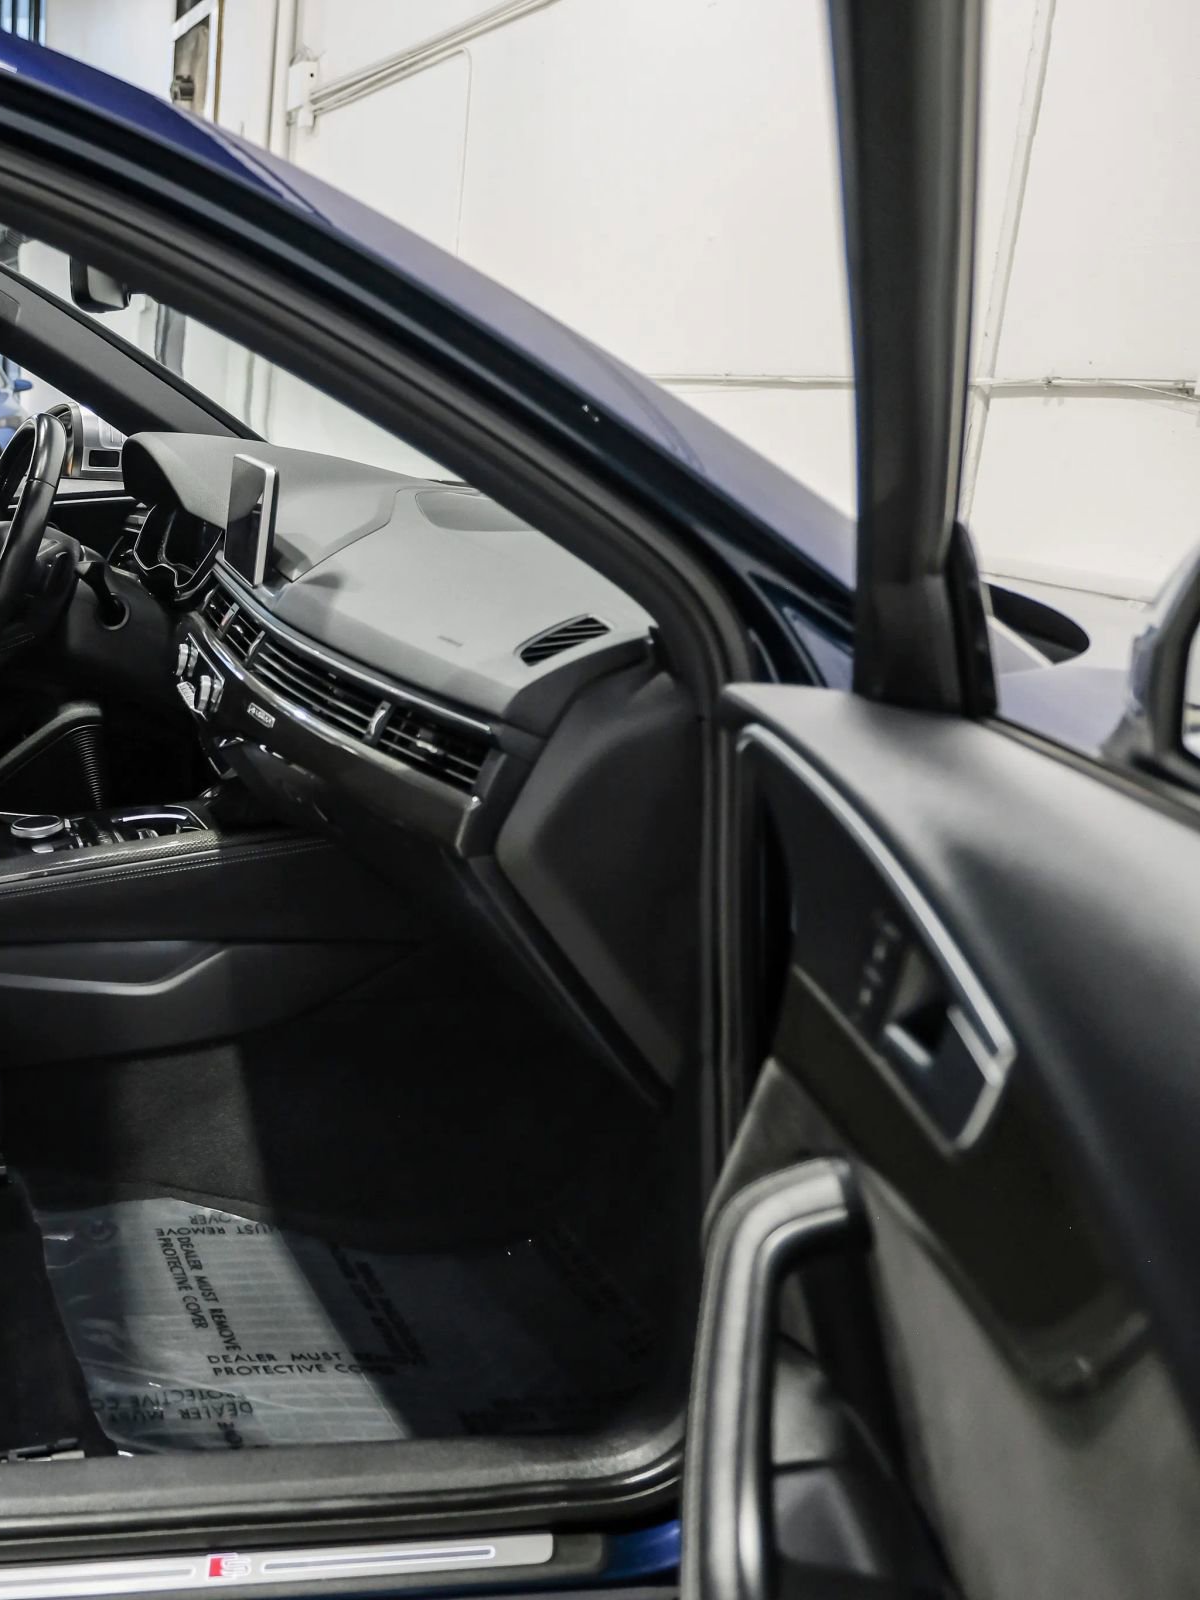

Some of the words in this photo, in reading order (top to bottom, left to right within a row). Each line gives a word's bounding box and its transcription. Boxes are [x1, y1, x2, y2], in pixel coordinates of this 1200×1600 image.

[156, 1226, 225, 1237] REMOVE
[158, 1237, 193, 1291] PROTECTIVE
[182, 1295, 209, 1329] COVER
[177, 1236, 203, 1271] DEALER
[194, 1275, 219, 1303] MUST
[208, 1308, 242, 1351] REMOVE
[207, 1353, 277, 1364] DEALER
[291, 1352, 343, 1362] MUST
[213, 1364, 327, 1377] PROTECTIVE
[130, 1389, 247, 1407] OTECTIVE
[179, 1401, 253, 1420] DEALER
